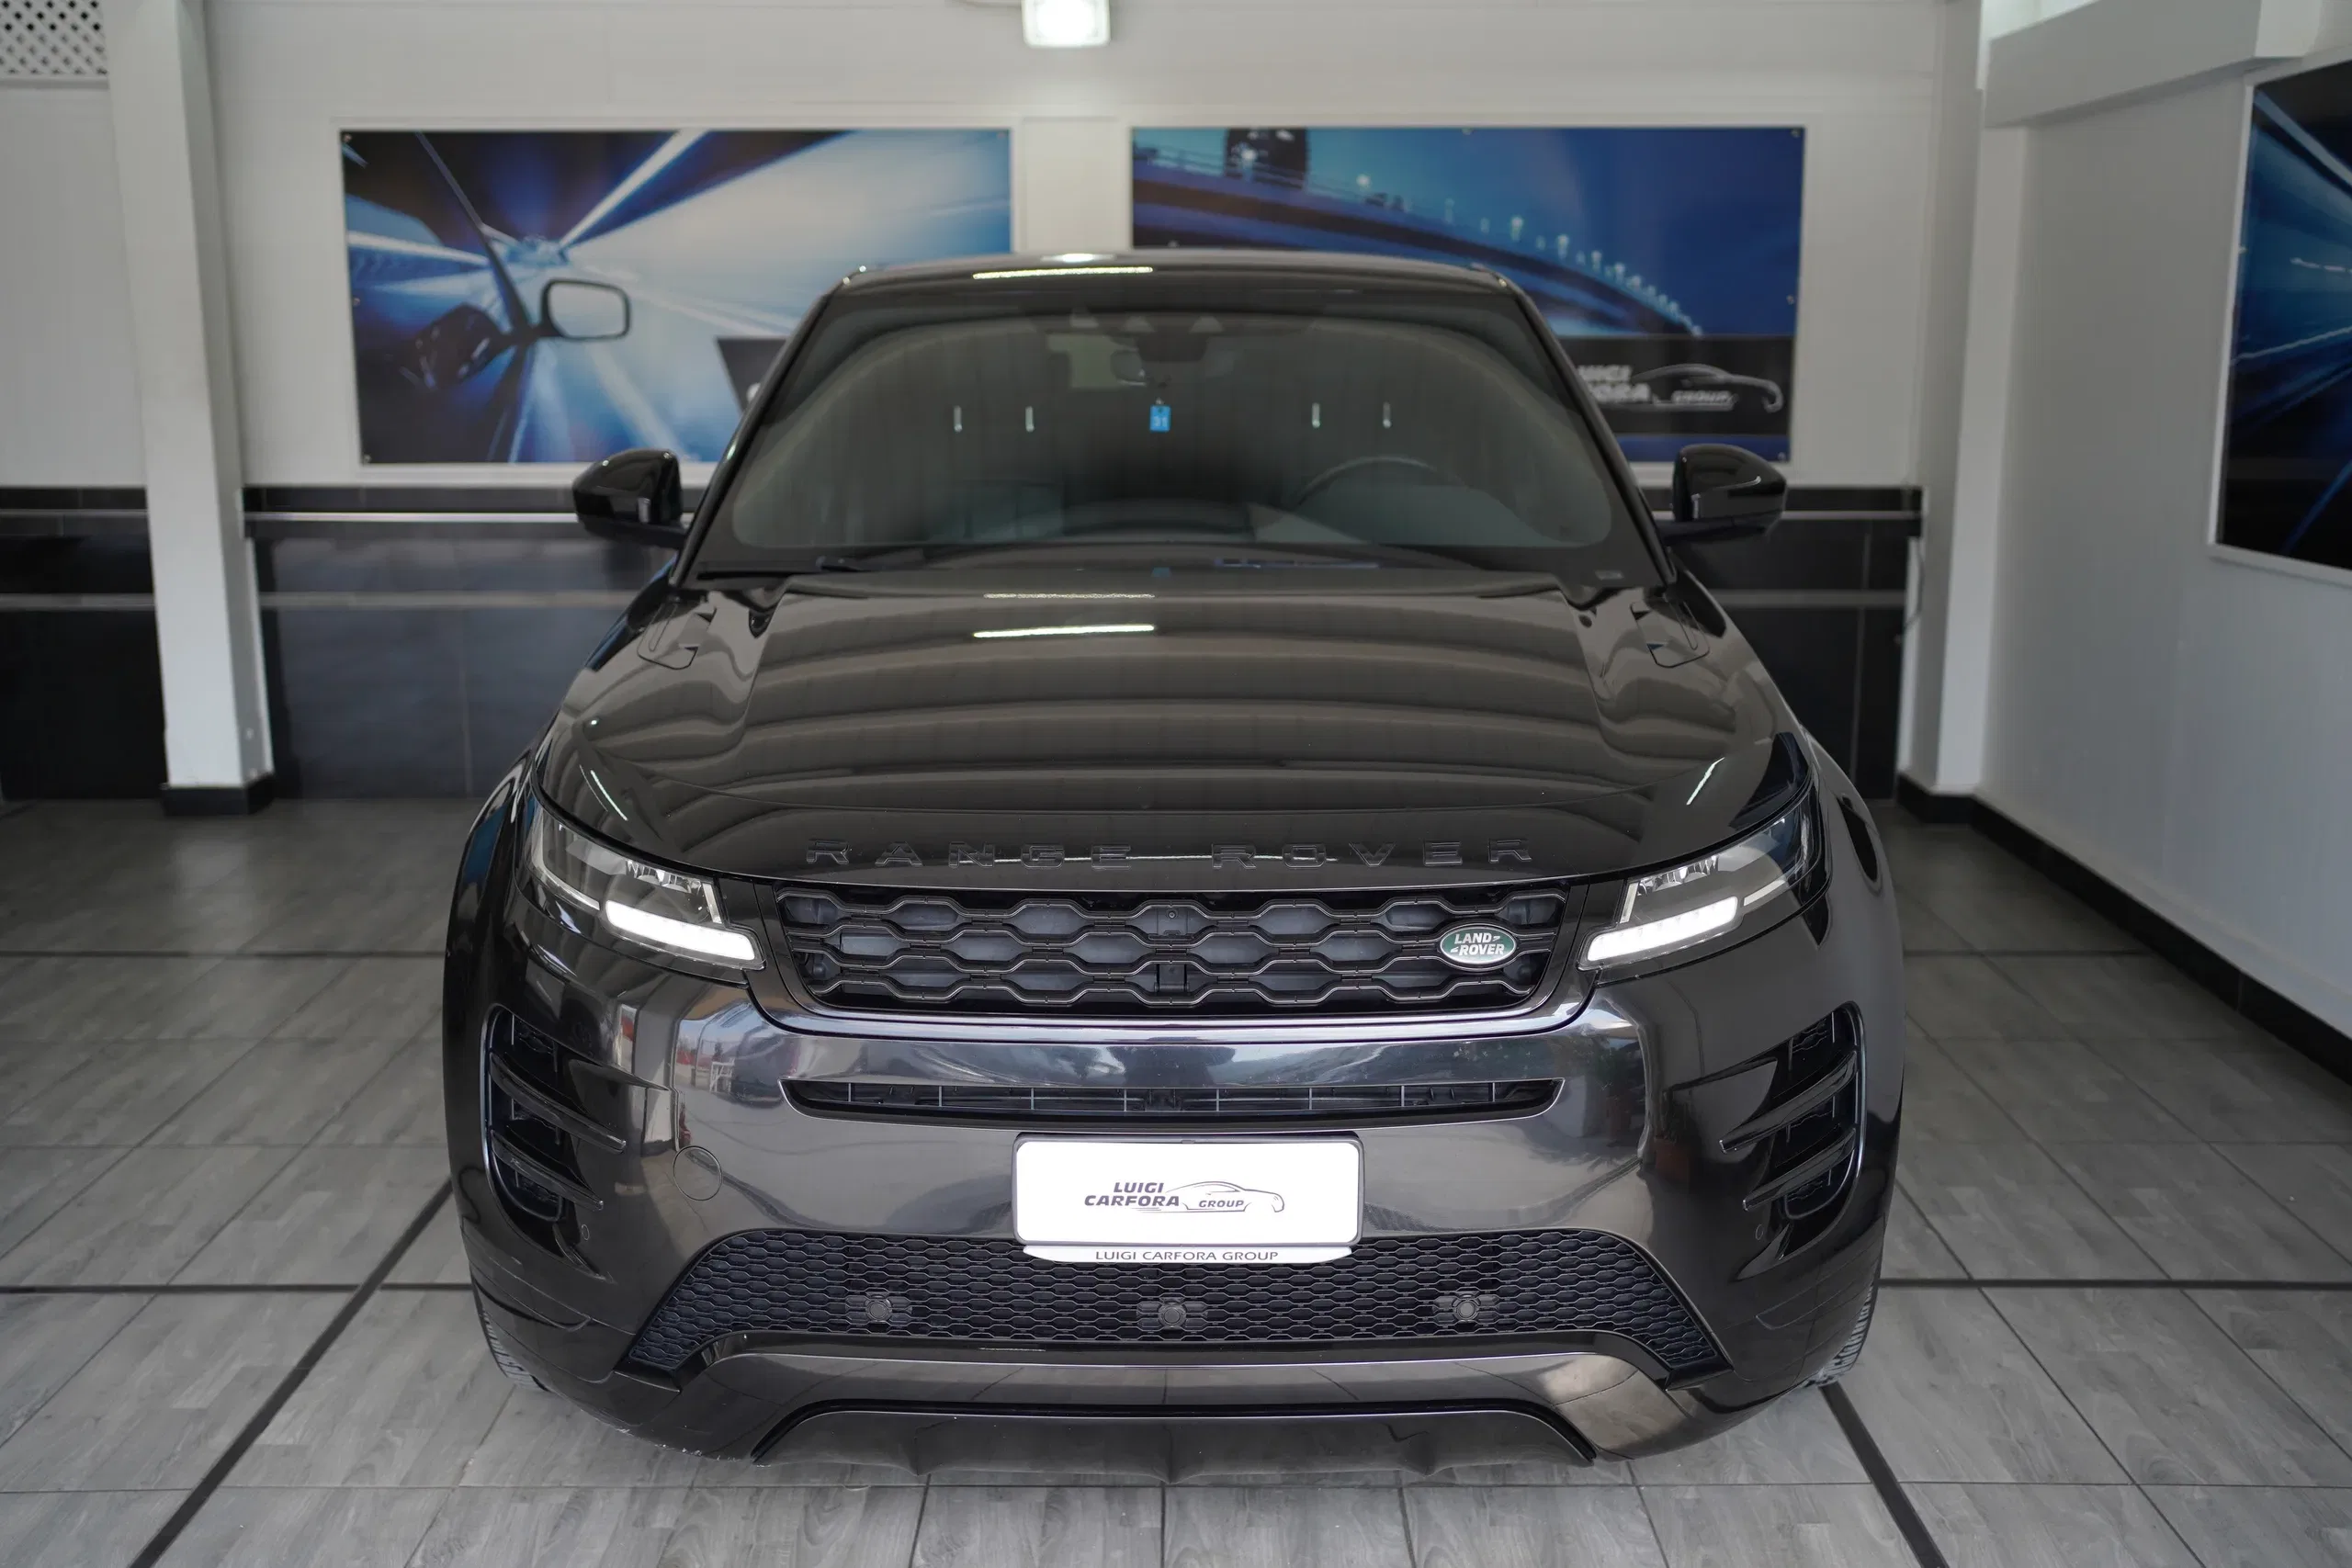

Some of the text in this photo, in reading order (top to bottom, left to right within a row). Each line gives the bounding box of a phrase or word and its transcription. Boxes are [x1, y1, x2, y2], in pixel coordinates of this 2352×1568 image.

[806, 838, 1532, 871] RANGE ROVER
[1454, 932, 1492, 944] LAND
[1459, 943, 1505, 956] ROVER
[1114, 1182, 1165, 1193] LUIGI
[1084, 1195, 1245, 1208] CARFORA GROUP
[1096, 1251, 1279, 1261] LUIGI CARFORA GROUP
